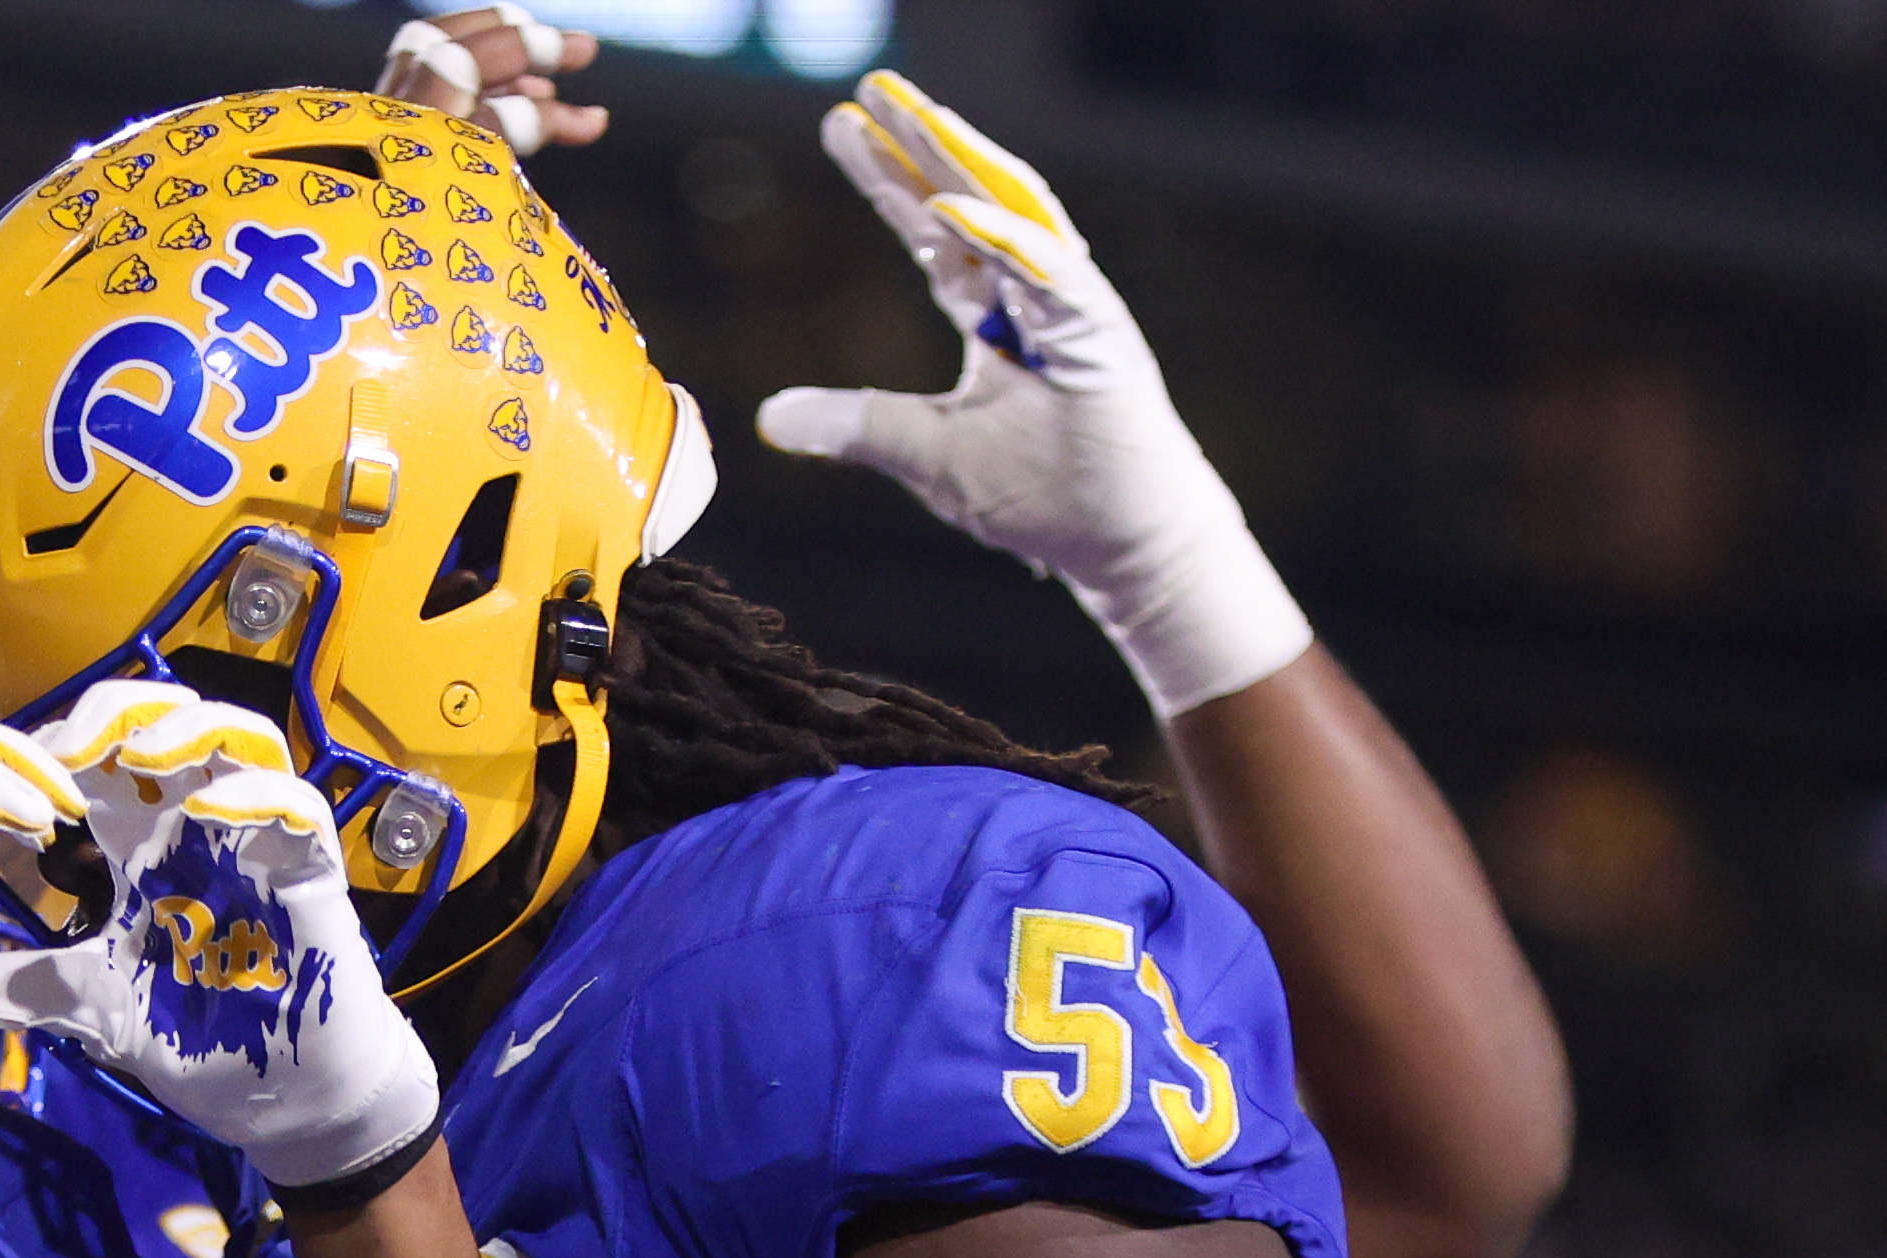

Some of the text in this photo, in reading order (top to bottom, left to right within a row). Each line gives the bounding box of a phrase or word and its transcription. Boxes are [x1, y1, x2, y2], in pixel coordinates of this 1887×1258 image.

[44, 220, 385, 506] Pitt
[152, 896, 286, 991] Pitt
[1002, 908, 1240, 1168] 53
